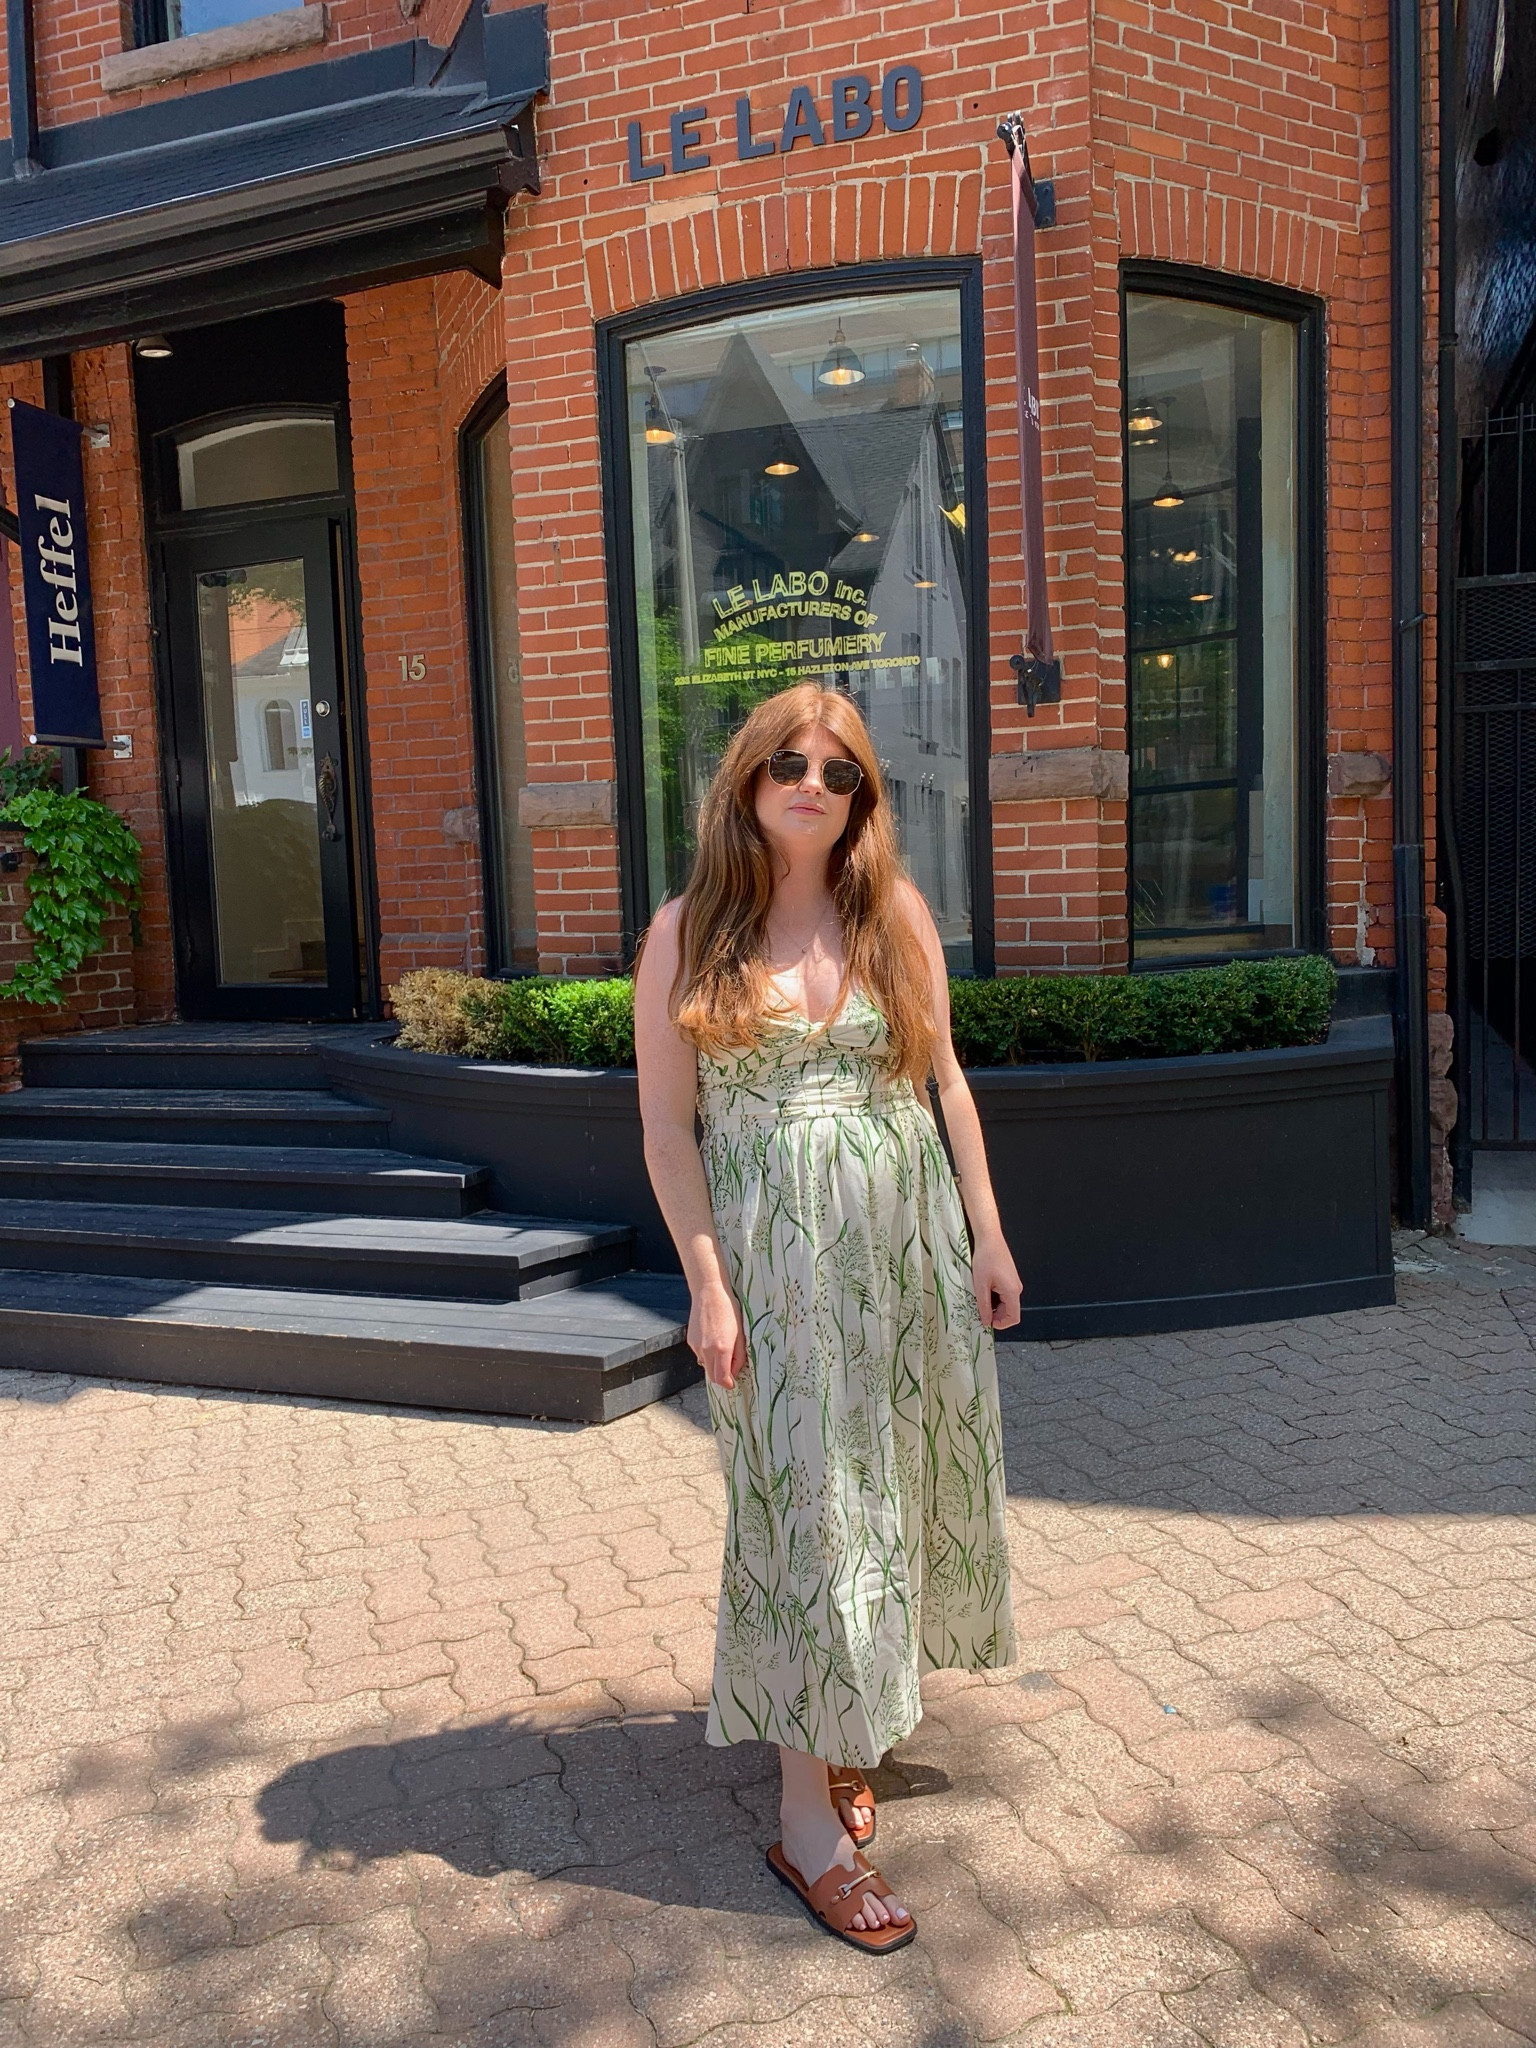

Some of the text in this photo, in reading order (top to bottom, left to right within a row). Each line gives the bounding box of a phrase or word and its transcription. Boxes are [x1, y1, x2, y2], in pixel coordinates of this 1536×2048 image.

[628, 65, 923, 182] LE LABO
[34, 494, 83, 667] Heffel
[713, 571, 868, 619] LE LABO Inc.
[713, 601, 879, 642] MANUFACTURERS OF
[398, 654, 426, 681] 15
[691, 671, 742, 684] ELIZABETH
[742, 670, 756, 680] ST
[757, 668, 778, 679] NYC
[786, 667, 797, 677] 15
[798, 661, 849, 676] HAZLETON
[849, 659, 870, 671] AVE
[871, 655, 921, 669] TORONTO
[704, 632, 887, 668] FINE PERFUMERY
